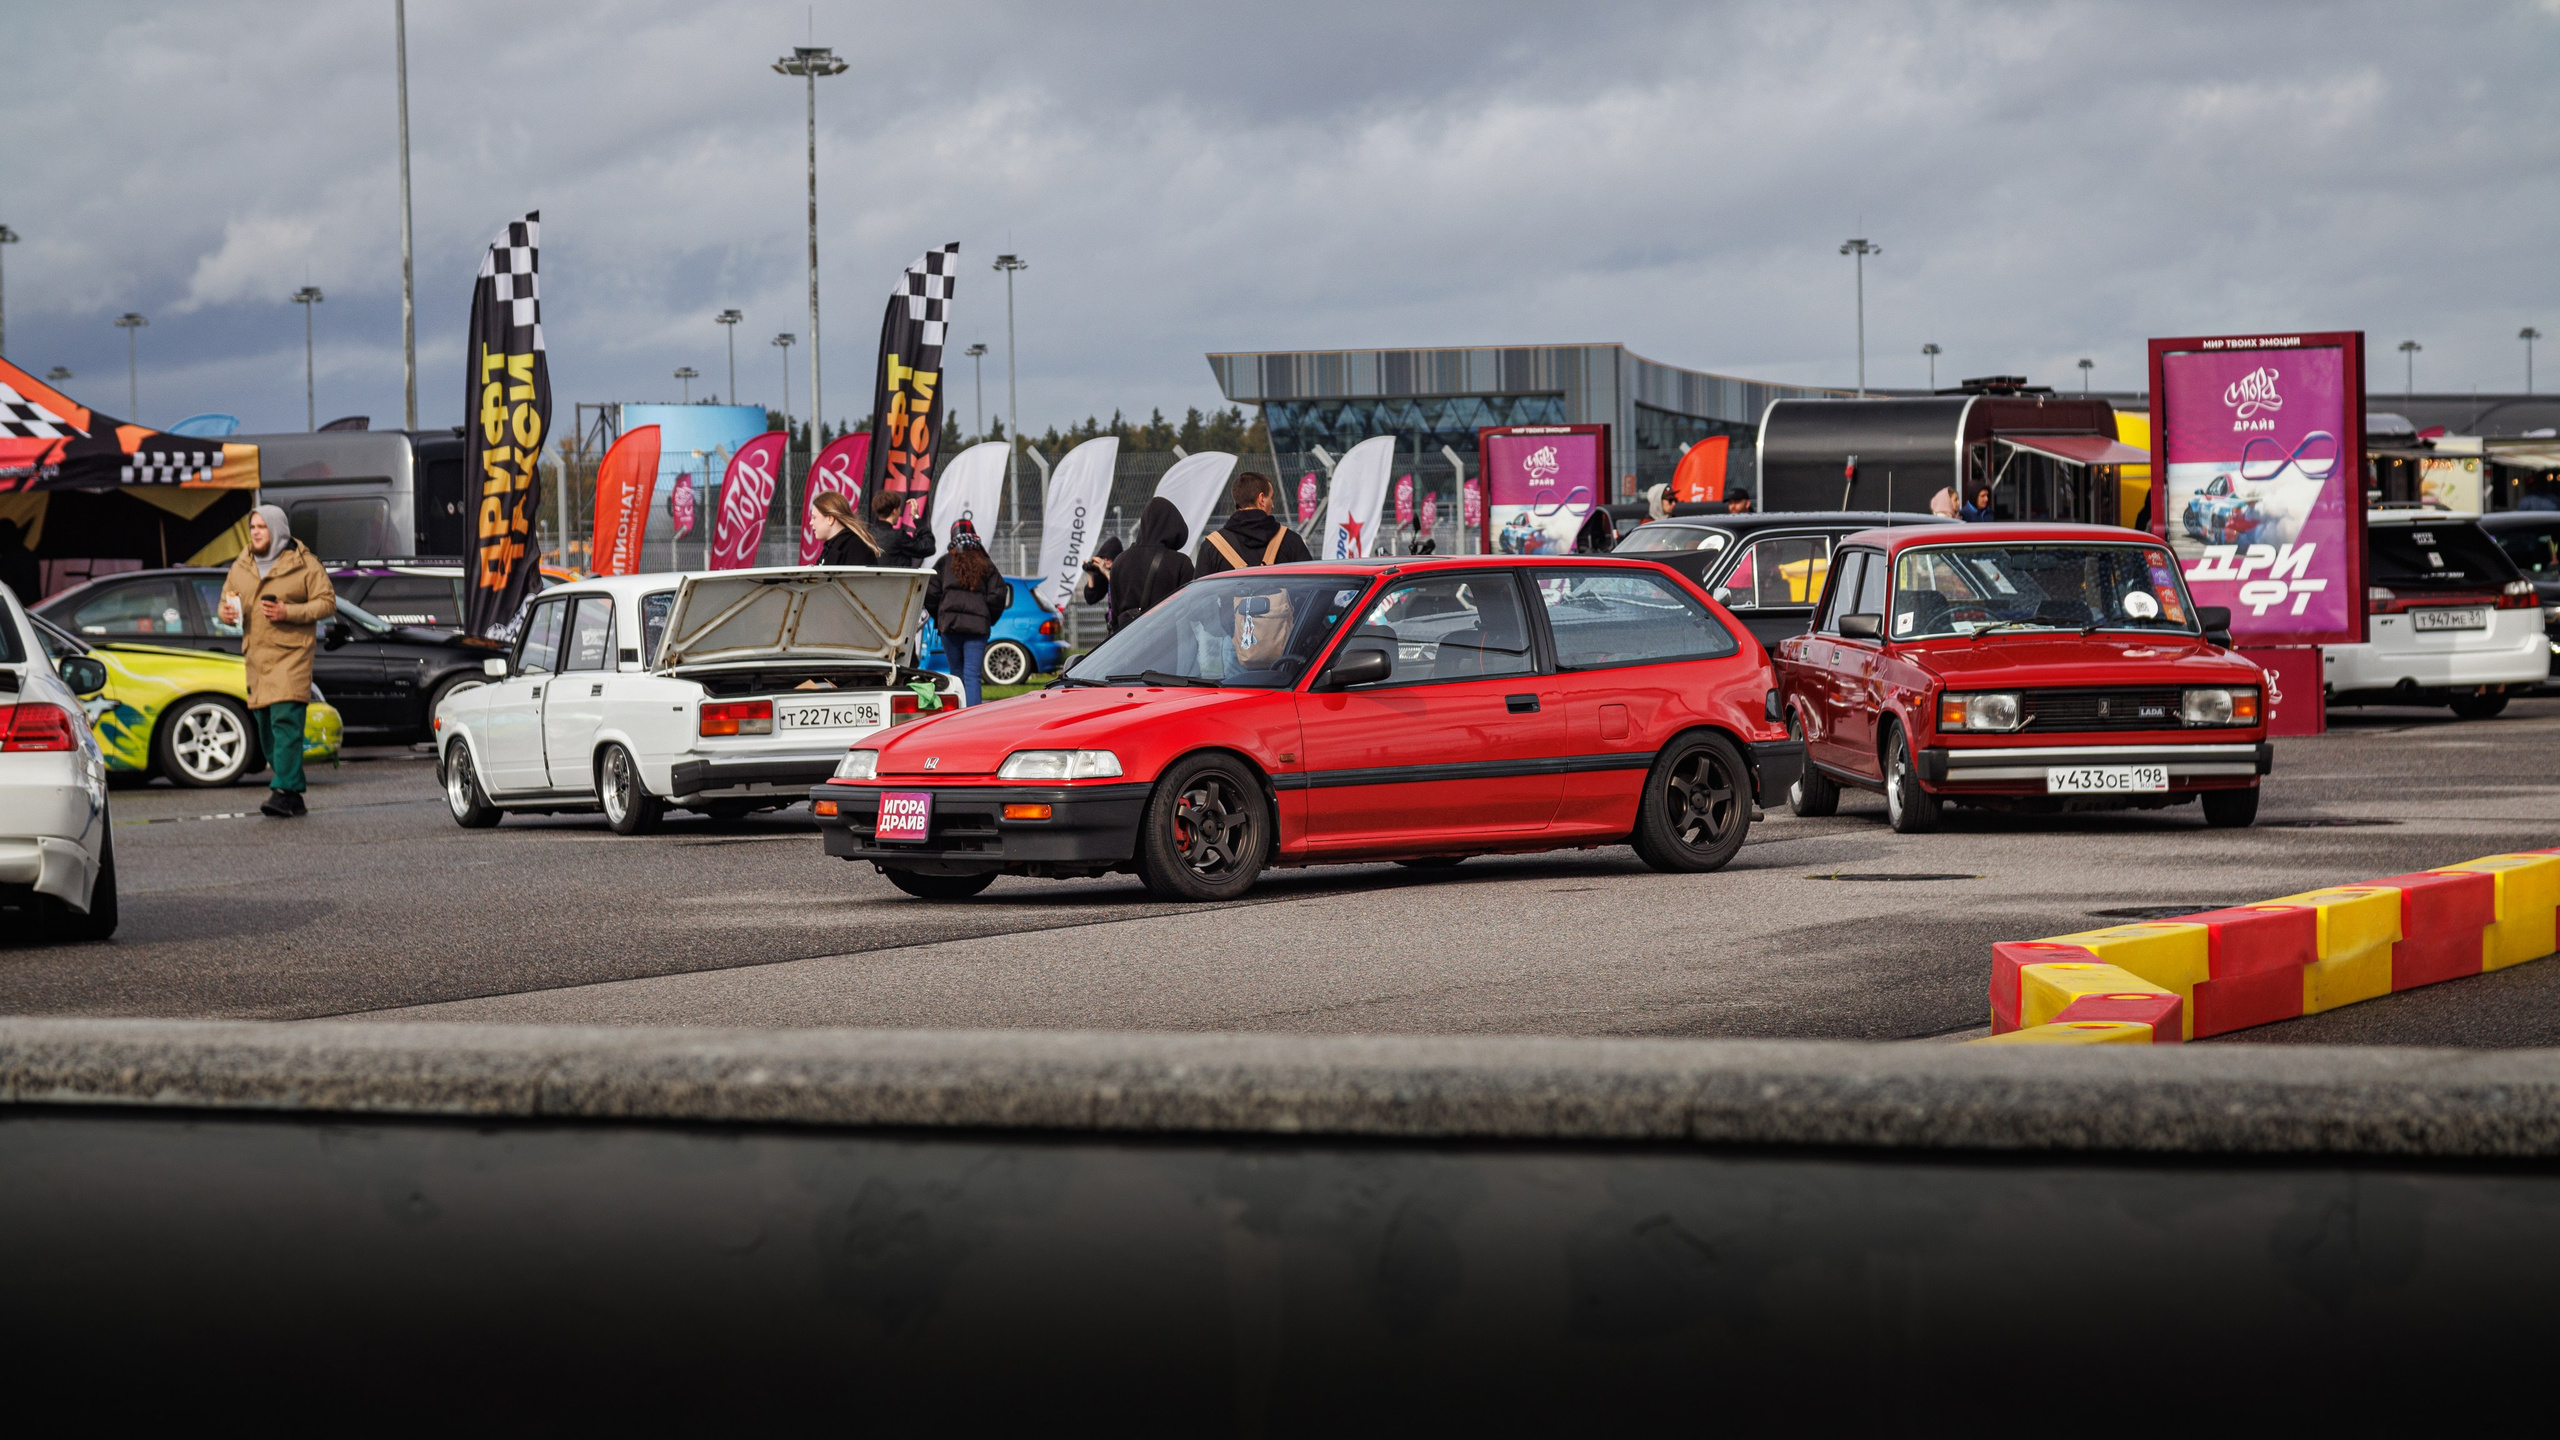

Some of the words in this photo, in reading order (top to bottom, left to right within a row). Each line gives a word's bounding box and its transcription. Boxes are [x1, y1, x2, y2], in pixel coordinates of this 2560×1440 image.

[2203, 340, 2224, 349] МИР
[2226, 338, 2257, 348] ТВОИХ
[884, 354, 913, 522] ИФТ
[2233, 418, 2275, 431] ДРАЙВ
[479, 342, 512, 592] ДРИФТ
[901, 370, 938, 534] АКСИ
[612, 481, 636, 576] ПИОНАТ
[1063, 506, 1087, 568] Видео
[2185, 542, 2317, 581] ДРИ
[1058, 572, 1076, 598] VK
[2239, 579, 2328, 616] ФТ
[857, 706, 873, 719] 98
[2141, 708, 2163, 716] LADA
[2134, 768, 2162, 783] 198
[884, 799, 926, 815] ИГОРА
